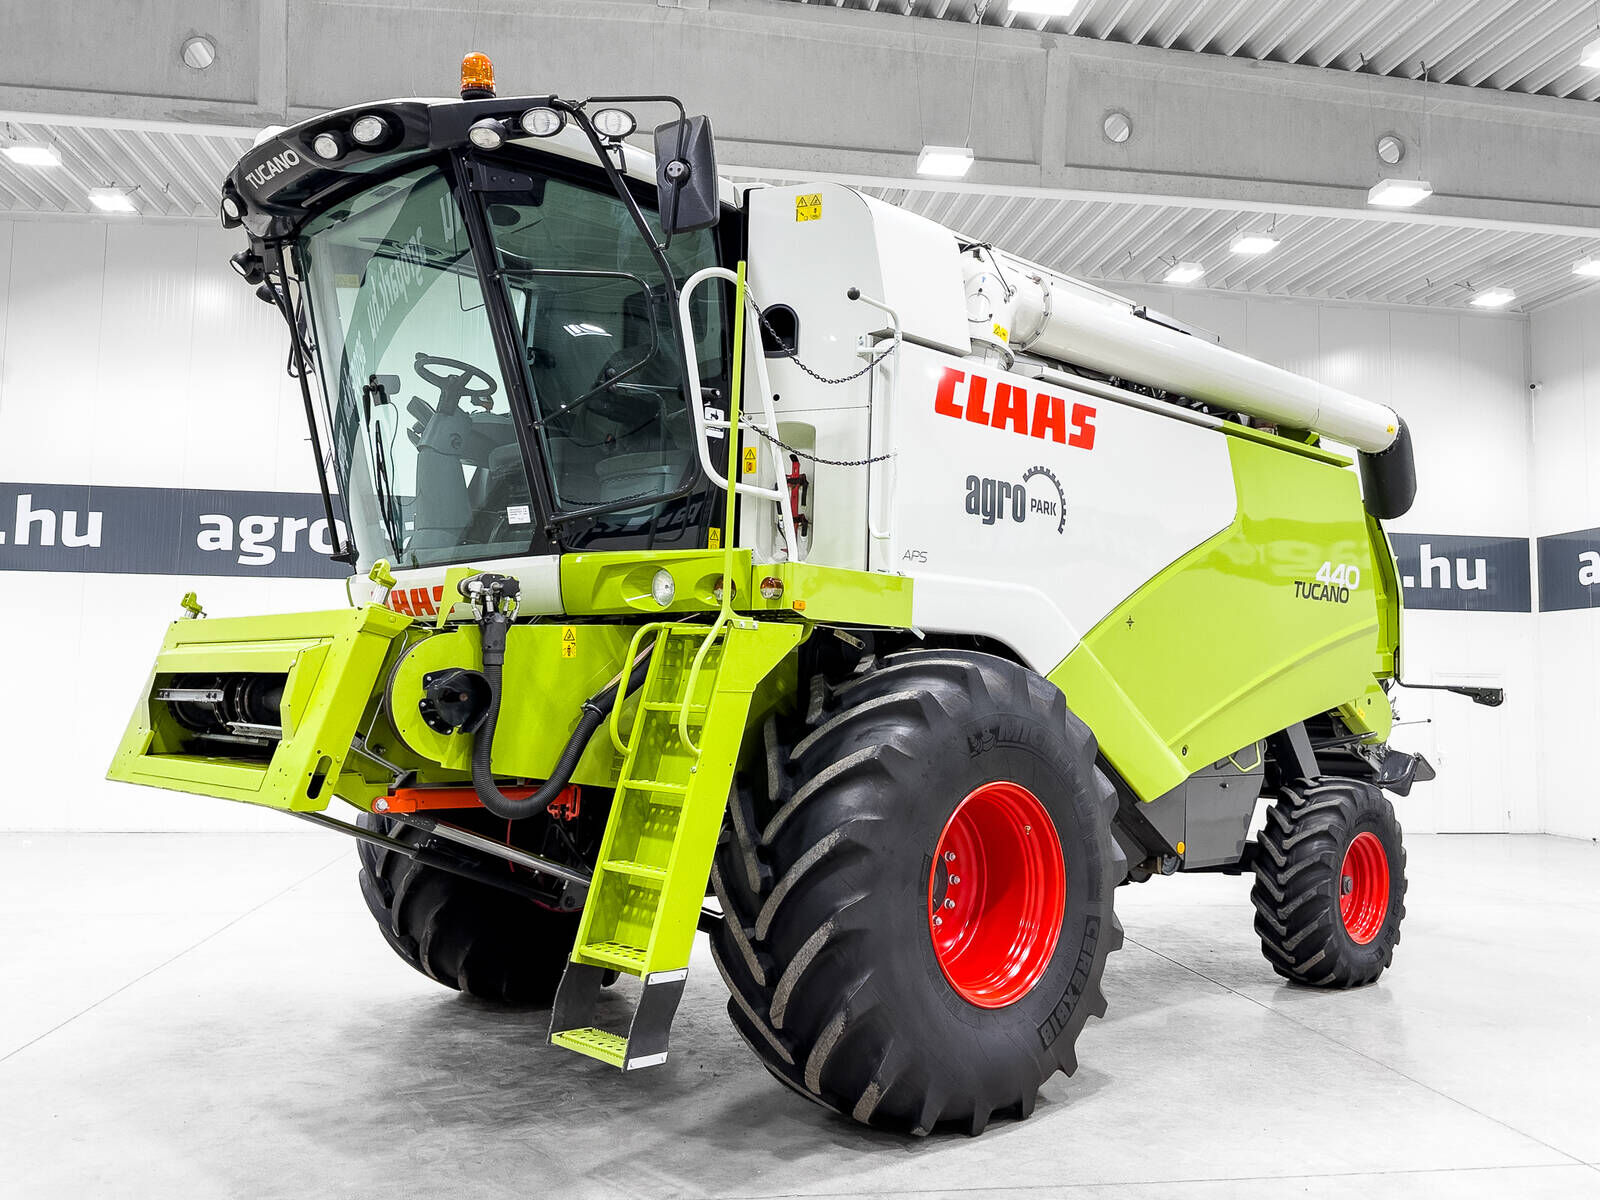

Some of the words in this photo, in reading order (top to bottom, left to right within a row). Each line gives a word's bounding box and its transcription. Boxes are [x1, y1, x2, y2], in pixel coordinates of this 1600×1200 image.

[244, 149, 300, 190] TUCANO
[935, 366, 1097, 450] CLAAS
[965, 475, 1026, 525] agro
[1030, 498, 1057, 516] PARK
[902, 549, 928, 563] APS
[1294, 580, 1349, 604] TUCANO
[1315, 561, 1360, 590] 440
